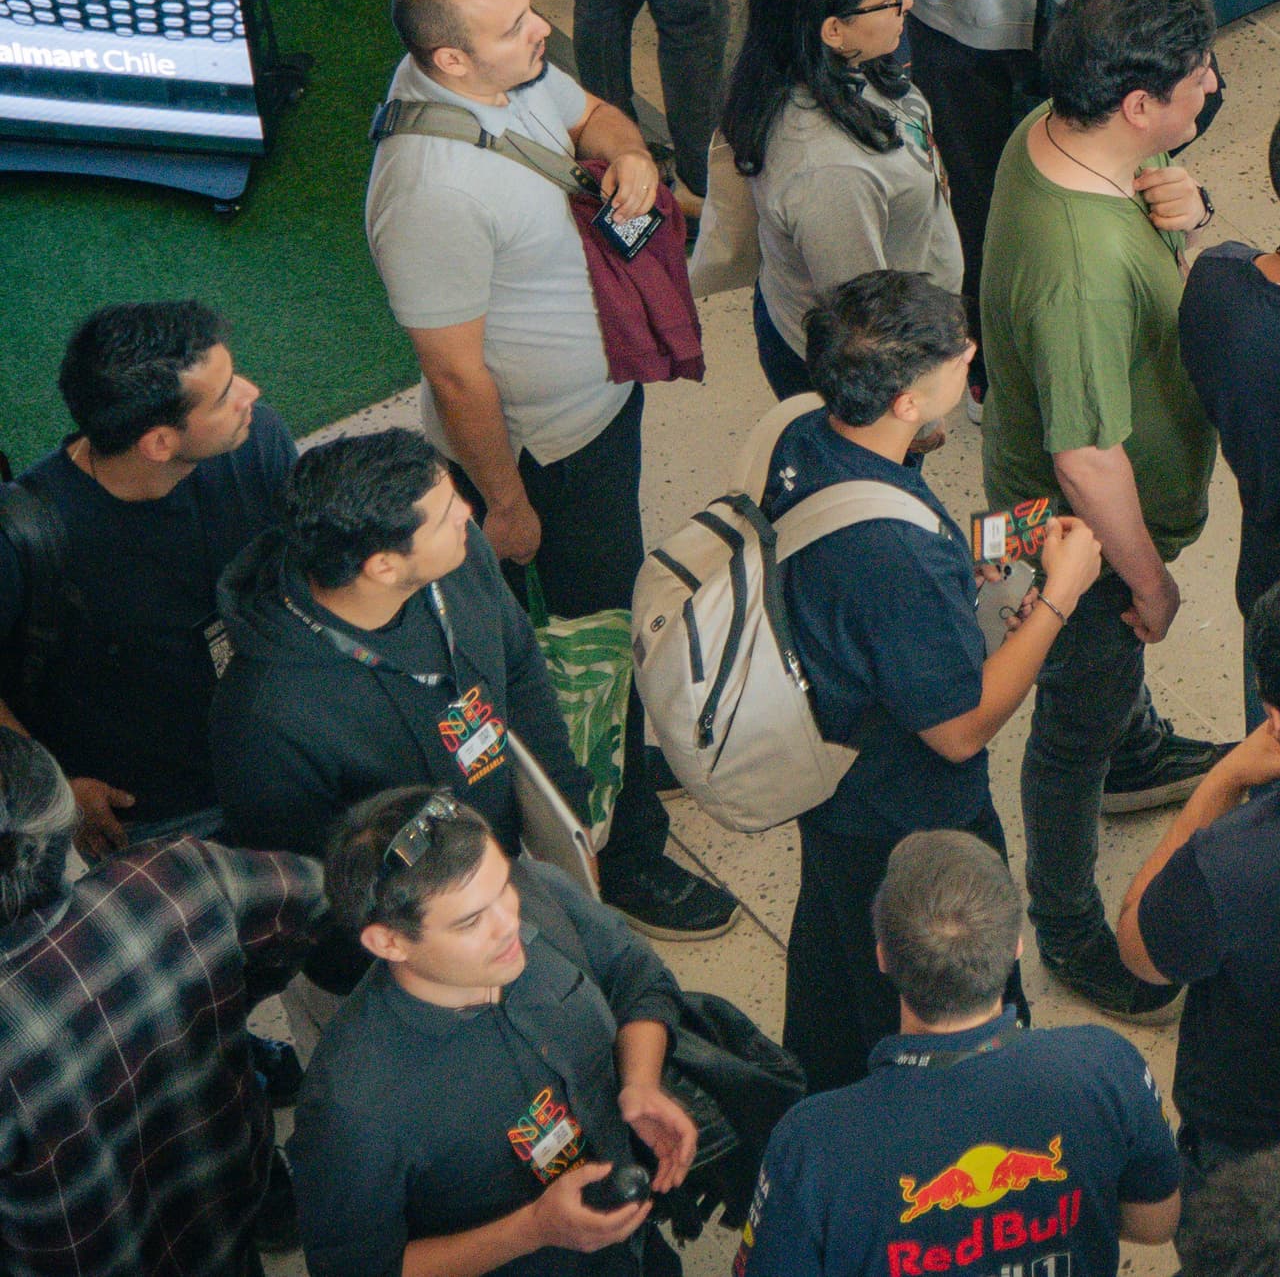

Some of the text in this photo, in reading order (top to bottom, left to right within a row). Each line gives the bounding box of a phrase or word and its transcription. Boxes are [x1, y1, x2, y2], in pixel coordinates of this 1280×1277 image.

[0, 41, 177, 76] almart Chile
[886, 1187, 1083, 1277] Red Bull
